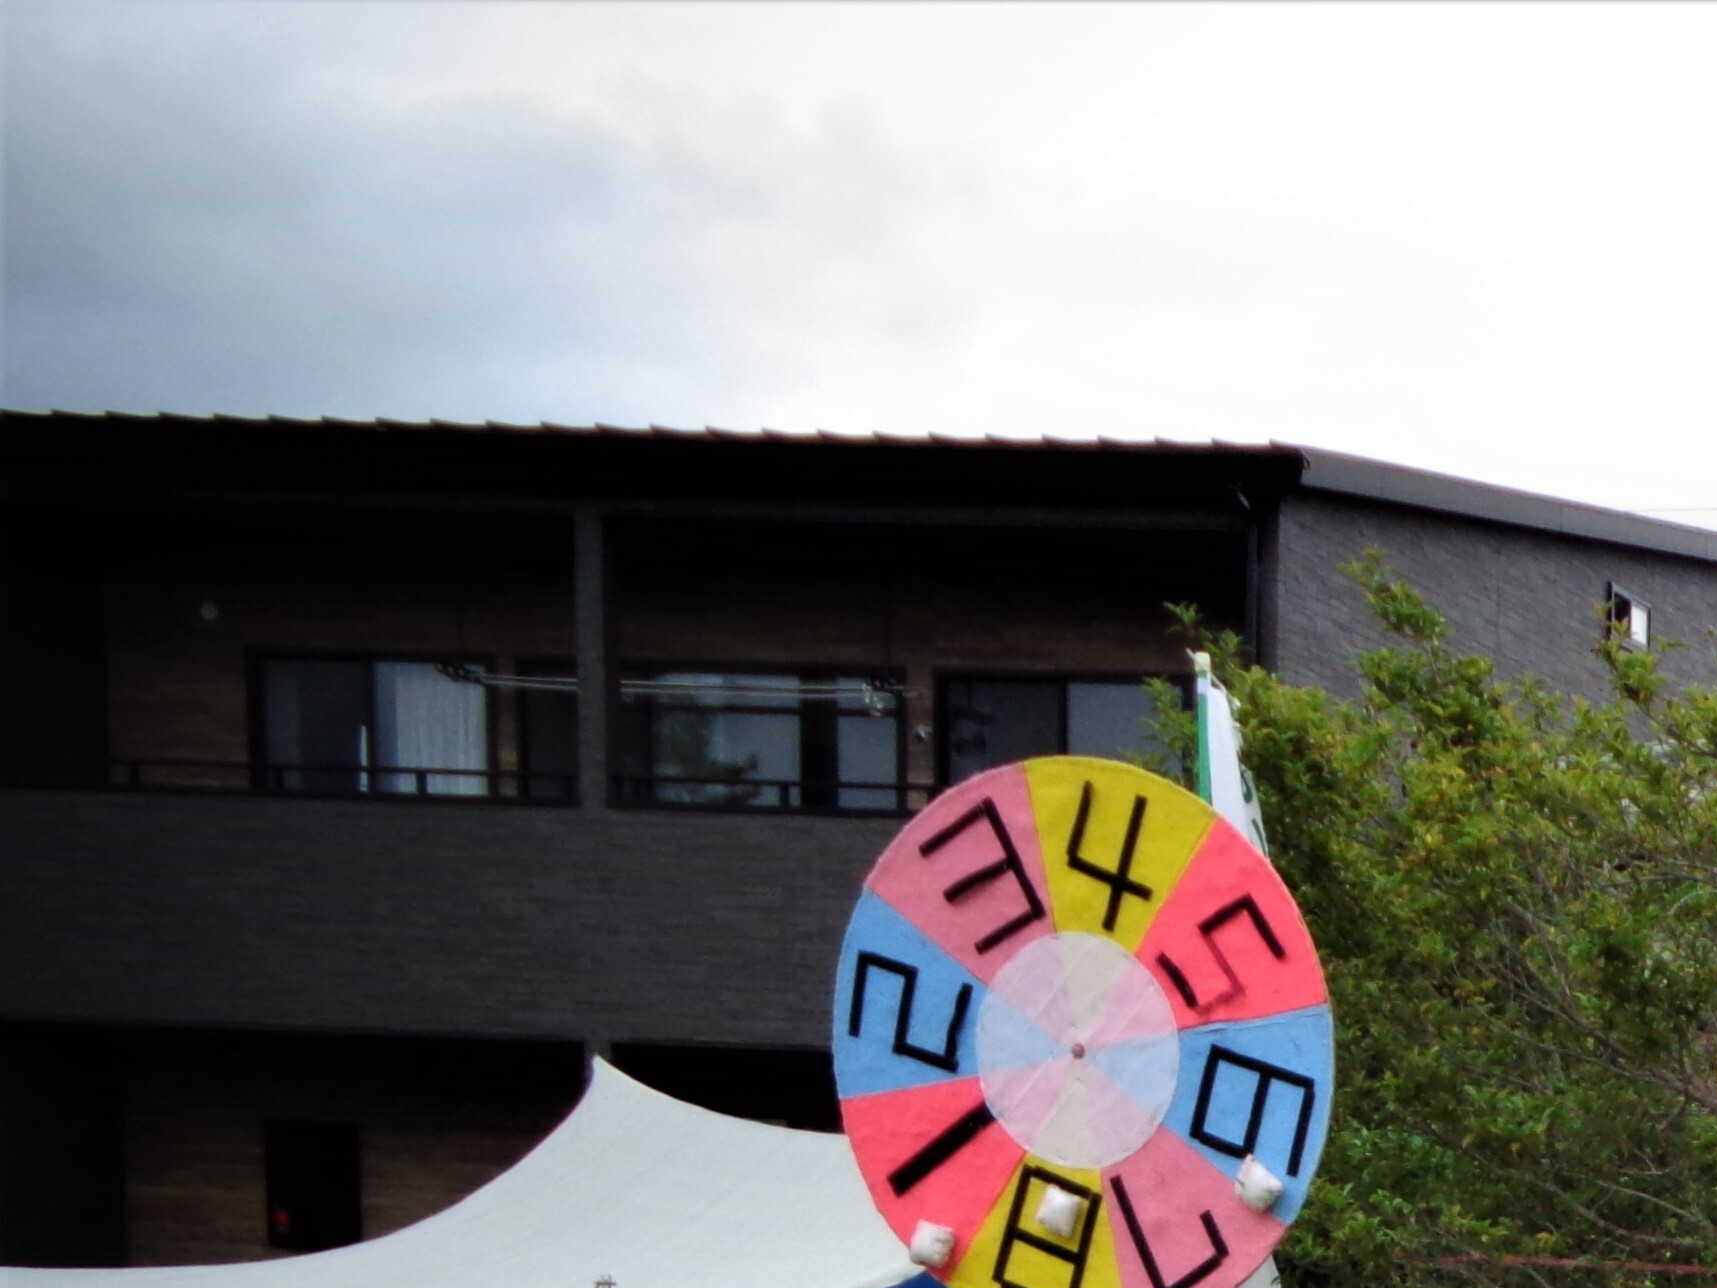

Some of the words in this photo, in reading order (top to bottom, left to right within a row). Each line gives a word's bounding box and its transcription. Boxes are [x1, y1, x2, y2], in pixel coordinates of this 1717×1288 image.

[919, 796, 1046, 954] 3
[1067, 780, 1153, 932] 4
[848, 950, 973, 1074] 2
[1156, 893, 1286, 1018] 5
[1190, 1044, 1315, 1177] 6
